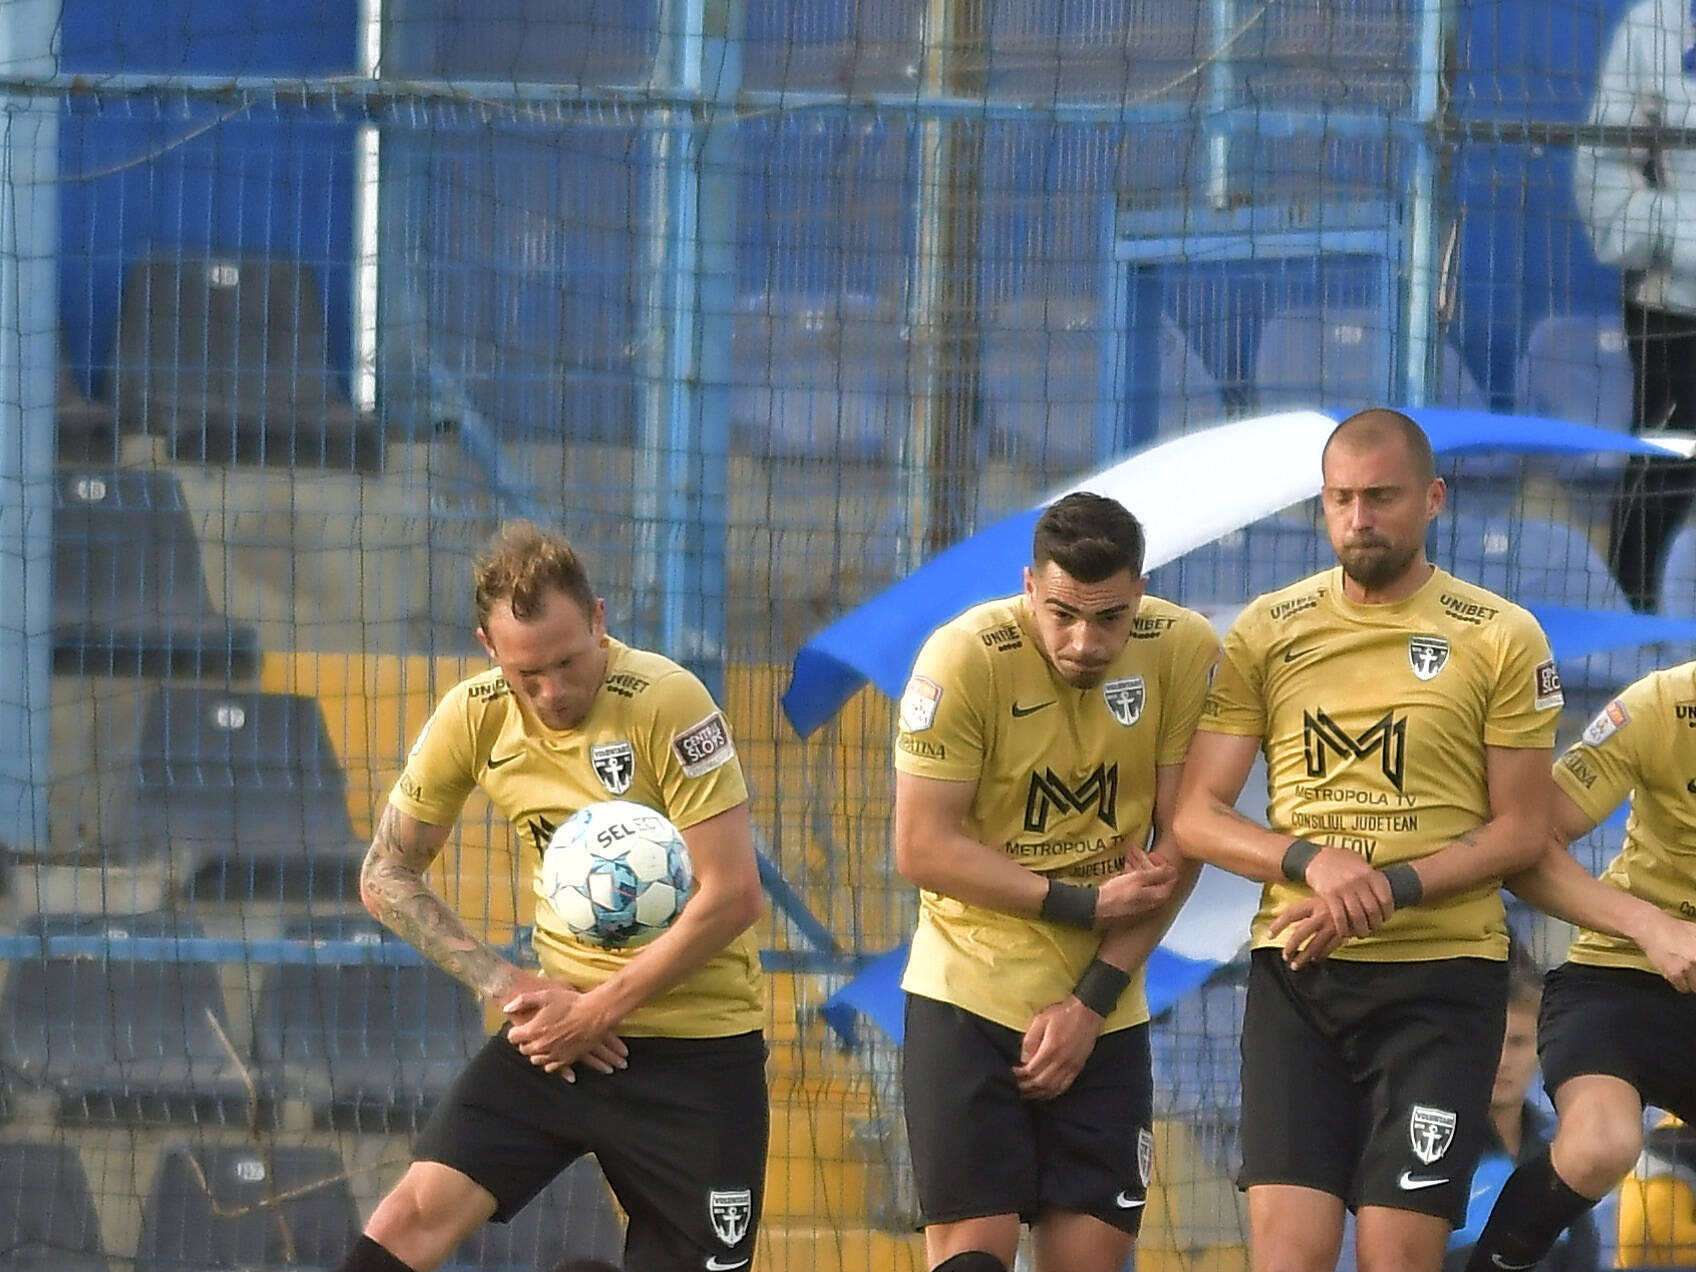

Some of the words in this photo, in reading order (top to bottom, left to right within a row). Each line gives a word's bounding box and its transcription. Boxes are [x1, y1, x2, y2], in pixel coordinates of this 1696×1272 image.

[1440, 594, 1499, 620] UNIBET
[1131, 618, 1177, 631] NIBET
[1295, 784, 1389, 806] METROPOLA
[1396, 793, 1417, 807] TV
[1291, 811, 1346, 831] CONSILIUL
[1351, 815, 1418, 832] JUDETEAN
[1004, 838, 1107, 857] METROPOLA
